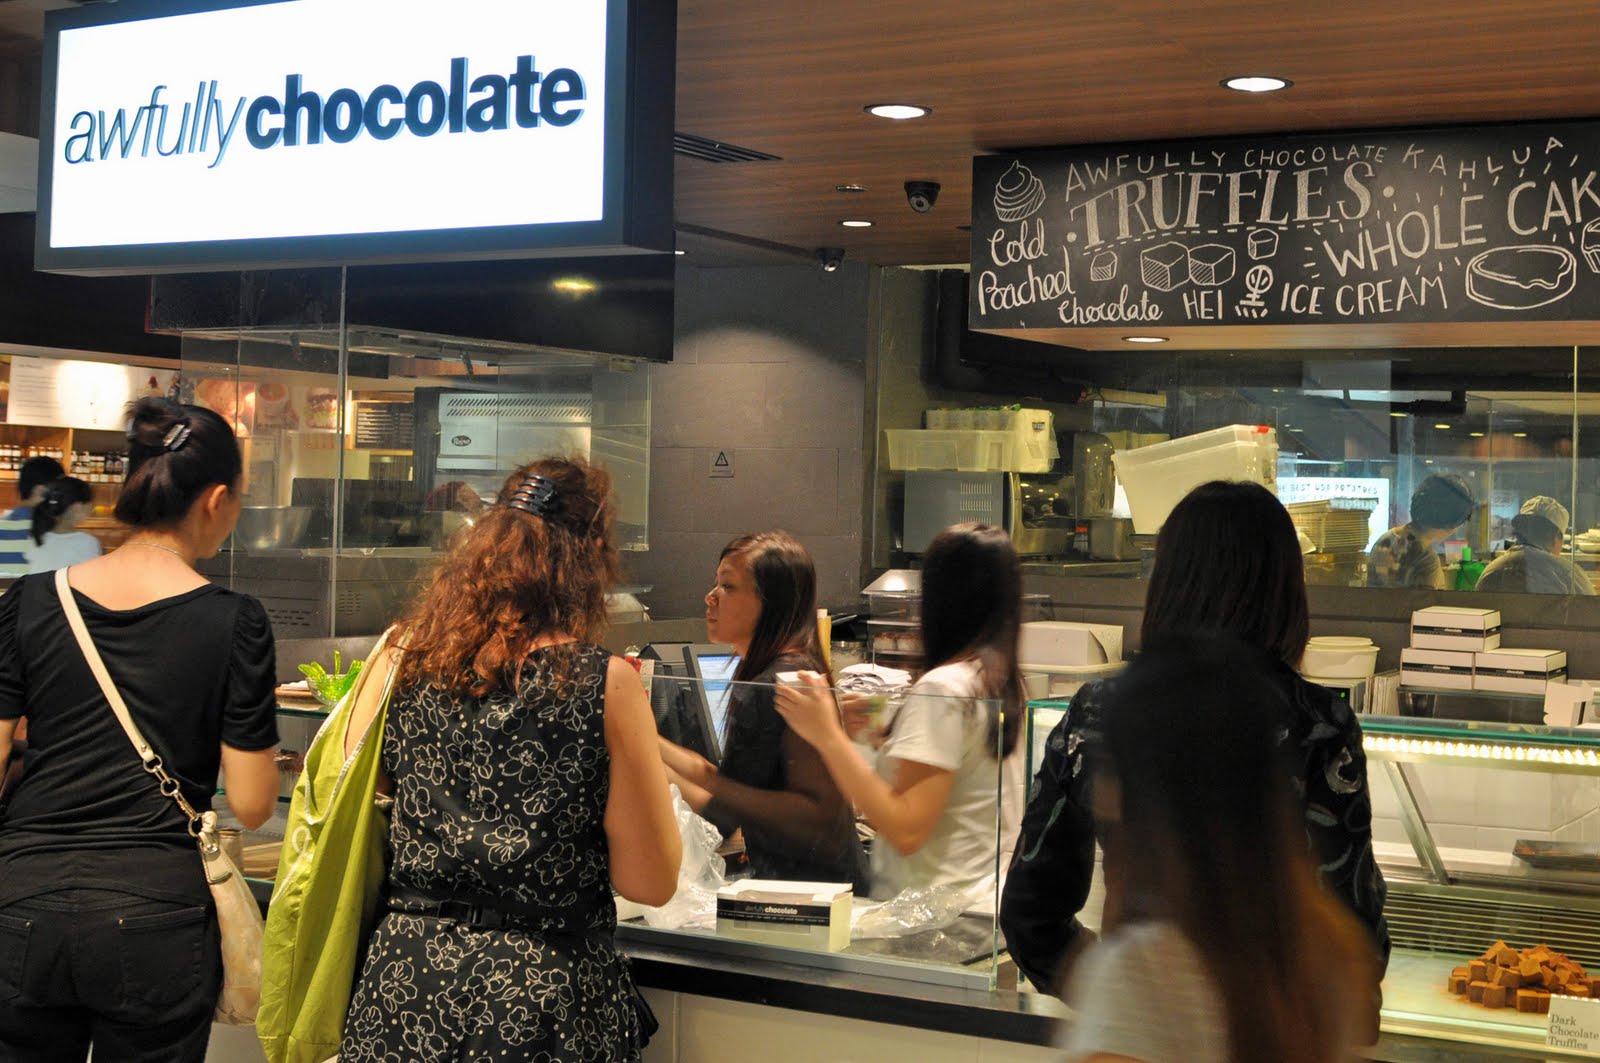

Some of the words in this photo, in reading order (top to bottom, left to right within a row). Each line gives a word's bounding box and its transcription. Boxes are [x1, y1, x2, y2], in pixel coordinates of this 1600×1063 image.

[1065, 151, 1226, 202] AWFULLY
[1244, 144, 1388, 167] CHOCOLATE
[1401, 136, 1564, 181] KAHLUA
[1069, 160, 1376, 250] TRUFFLES
[987, 217, 1049, 266] Cold
[1323, 194, 1488, 278] WHOLE
[1182, 289, 1223, 320] HEI
[1280, 282, 1326, 316] ICE
[1335, 275, 1449, 317] CREAM
[1549, 1025, 1600, 1040] Chocolate
[1549, 1036, 1588, 1049] Truffles
[1551, 1014, 1576, 1026] Dark
